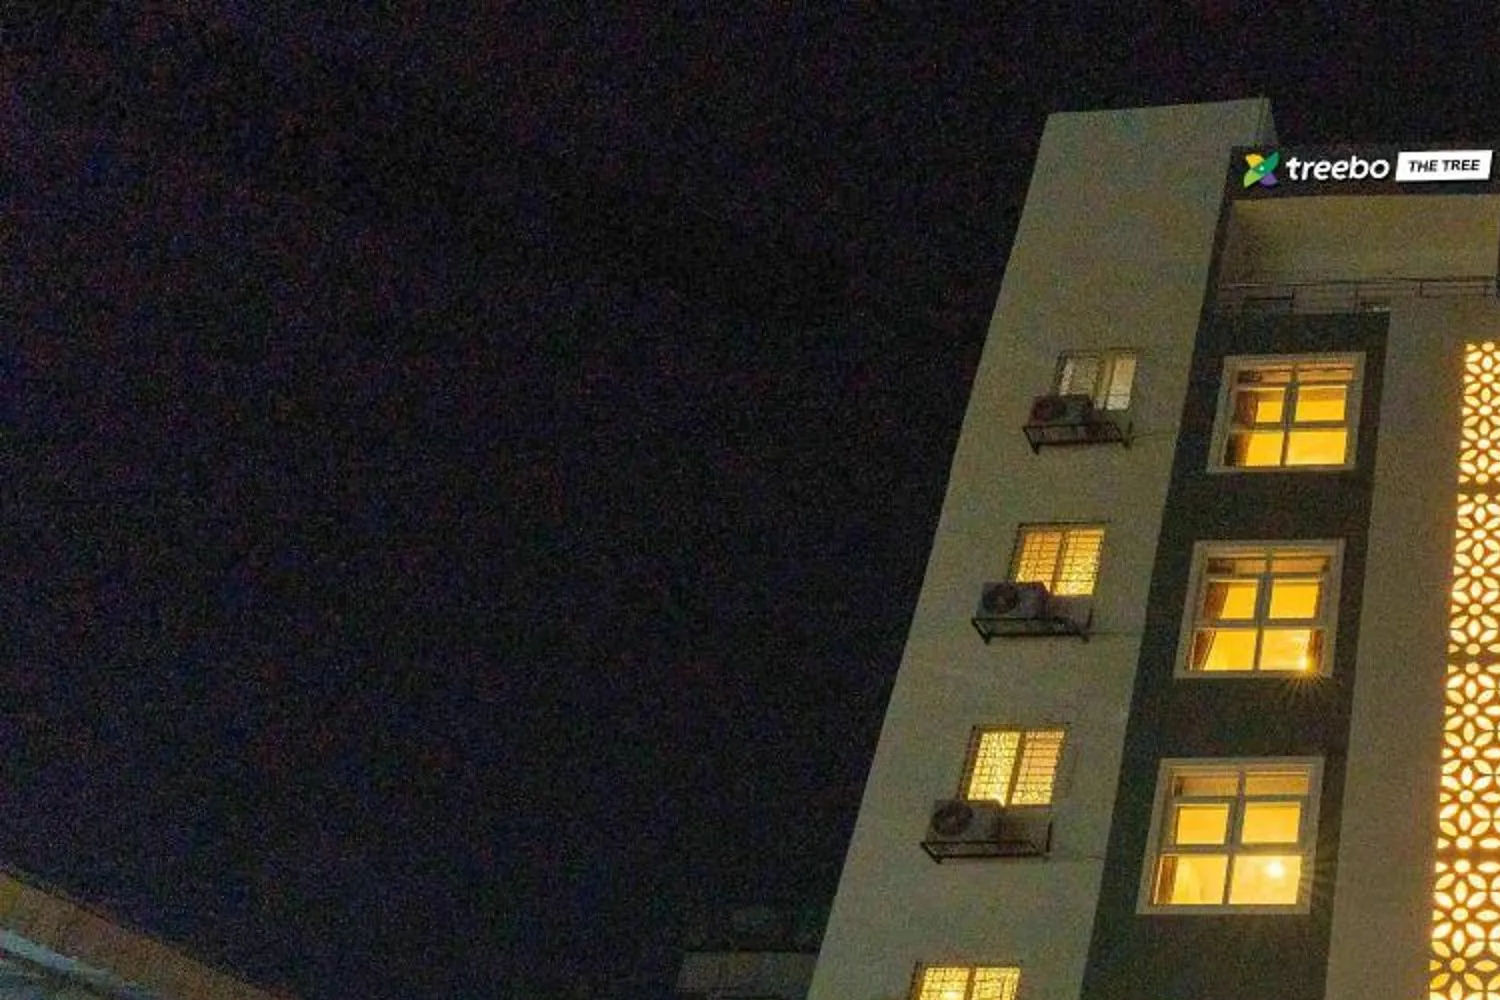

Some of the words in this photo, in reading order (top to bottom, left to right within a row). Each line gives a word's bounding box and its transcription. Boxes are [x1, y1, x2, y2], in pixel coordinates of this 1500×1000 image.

[1286, 155, 1390, 180] treebo
[1408, 160, 1437, 172] THE
[1443, 159, 1481, 171] TREE
